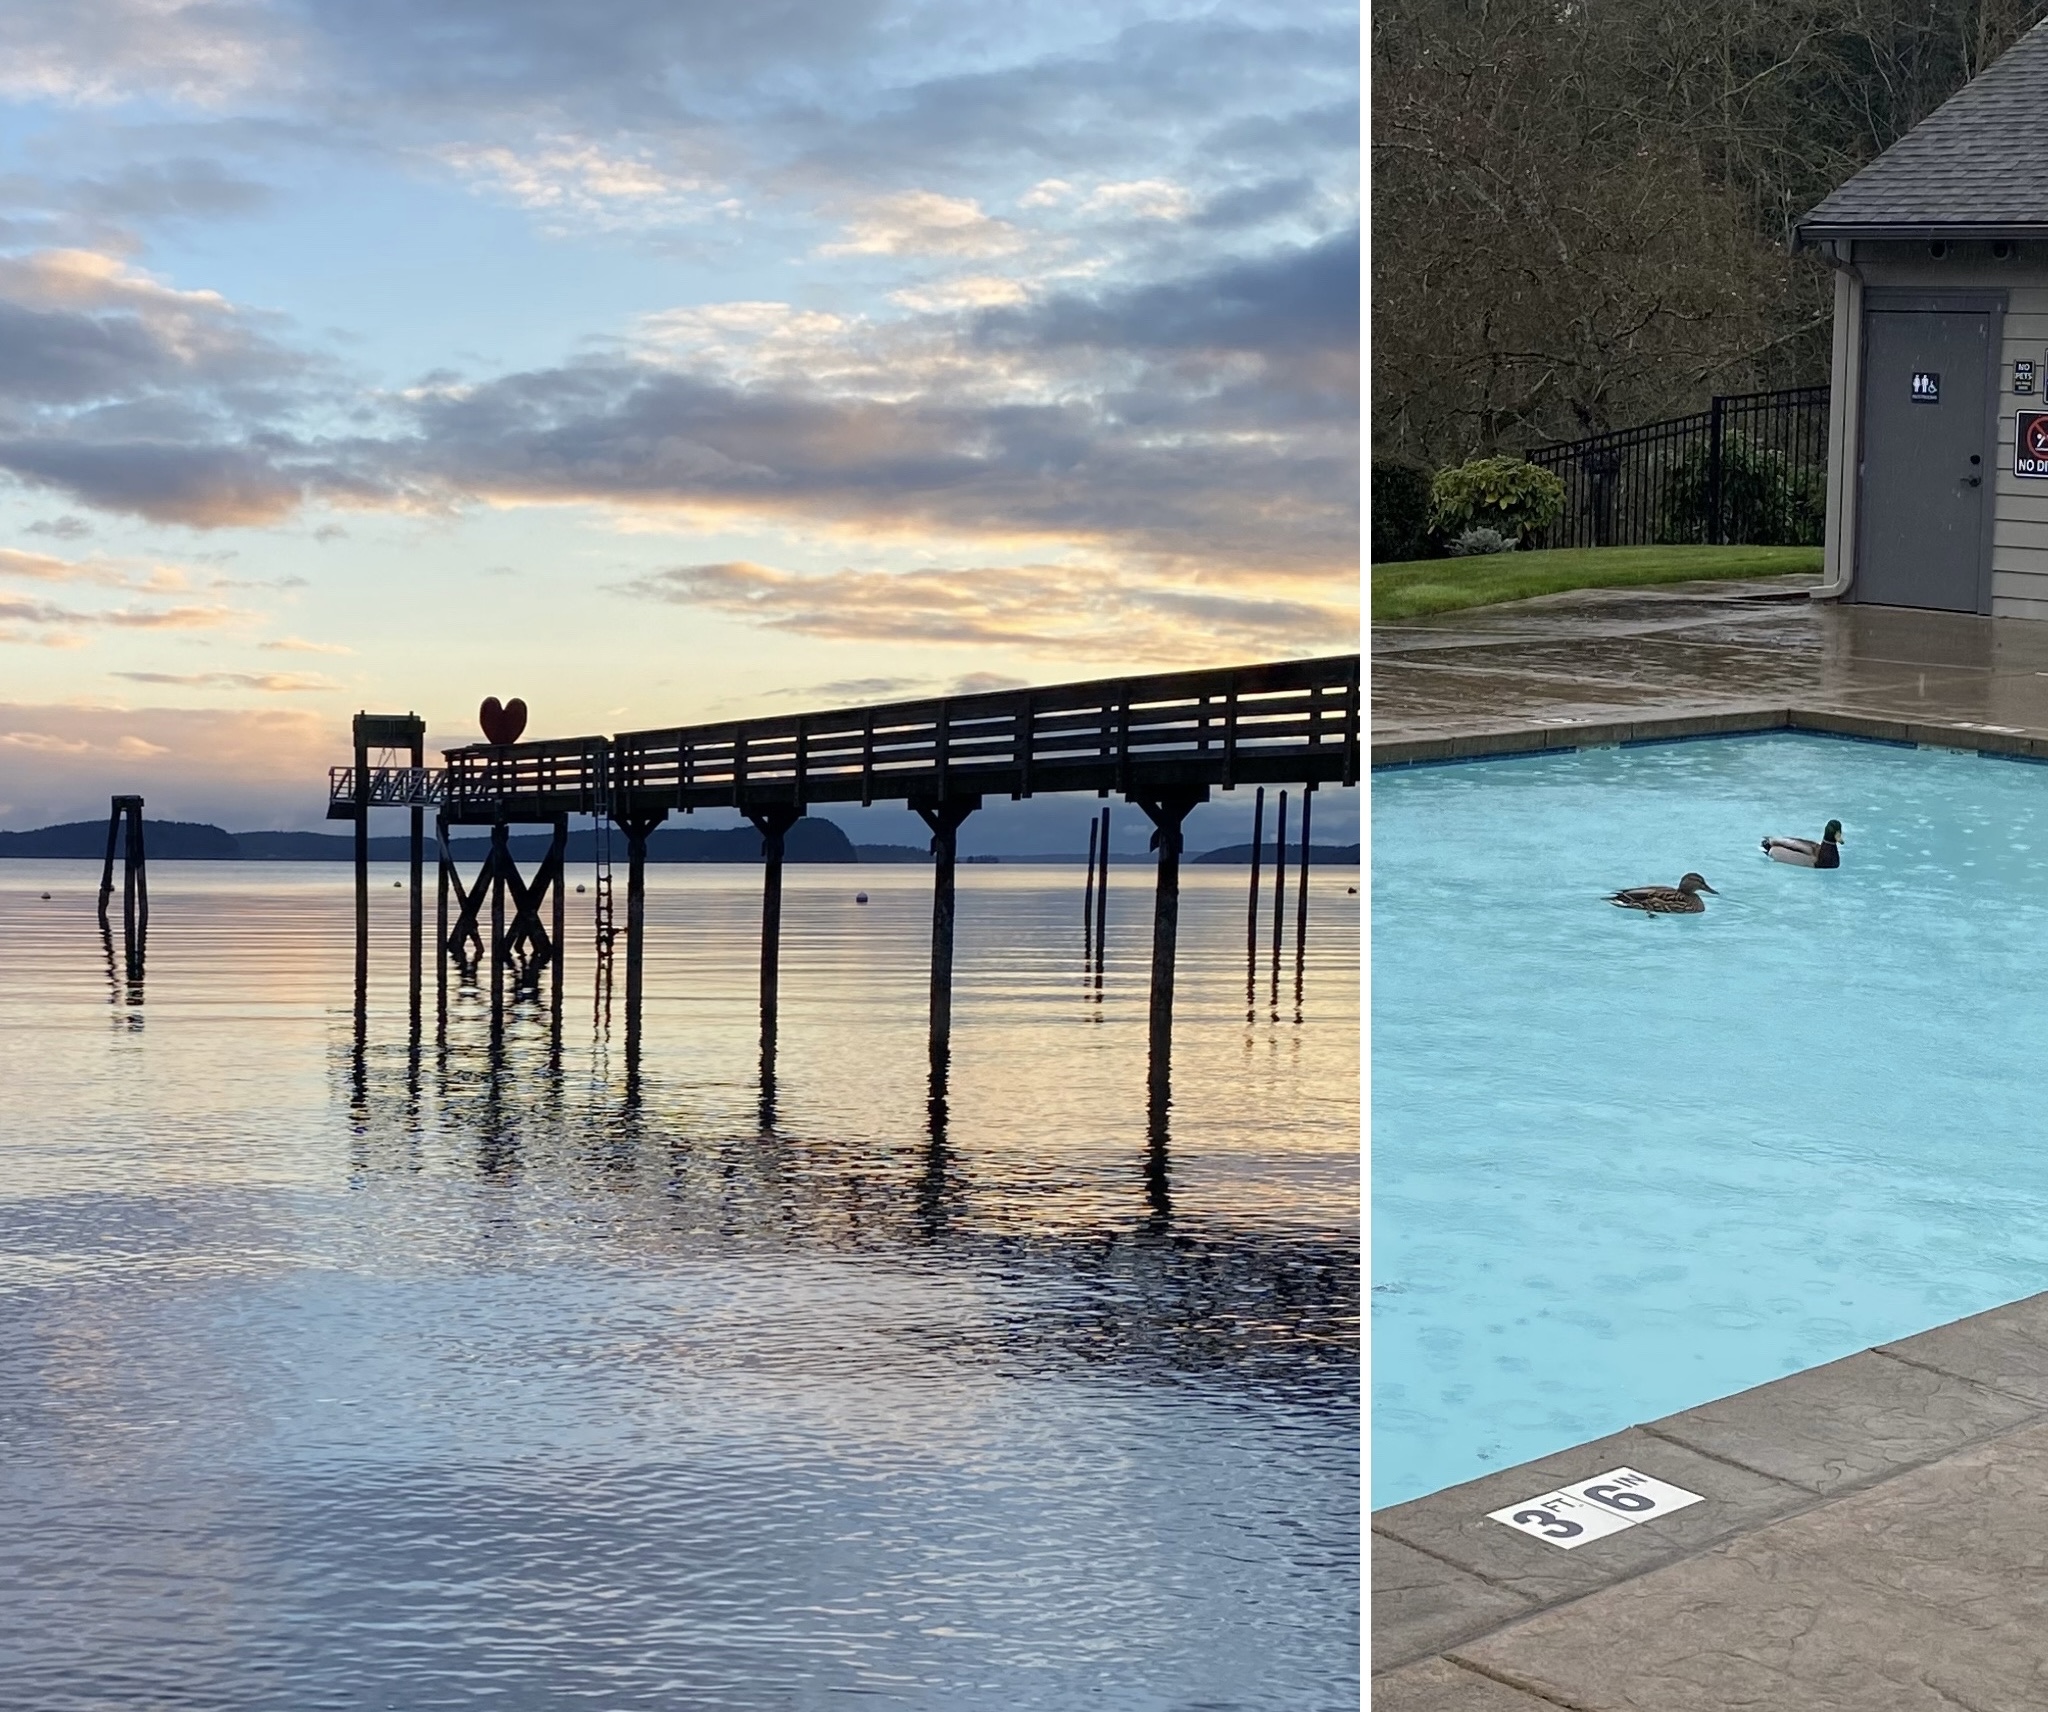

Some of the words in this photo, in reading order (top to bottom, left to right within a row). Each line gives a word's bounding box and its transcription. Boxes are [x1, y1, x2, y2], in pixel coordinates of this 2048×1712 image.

[2018, 363, 2030, 371] NO
[2015, 372, 2032, 380] PETS
[2018, 459, 2034, 471] NO
[1613, 1473, 1648, 1488] IN
[1541, 1497, 1575, 1513] FT
[1583, 1485, 1656, 1512] 6
[1513, 1509, 1584, 1538] 3
